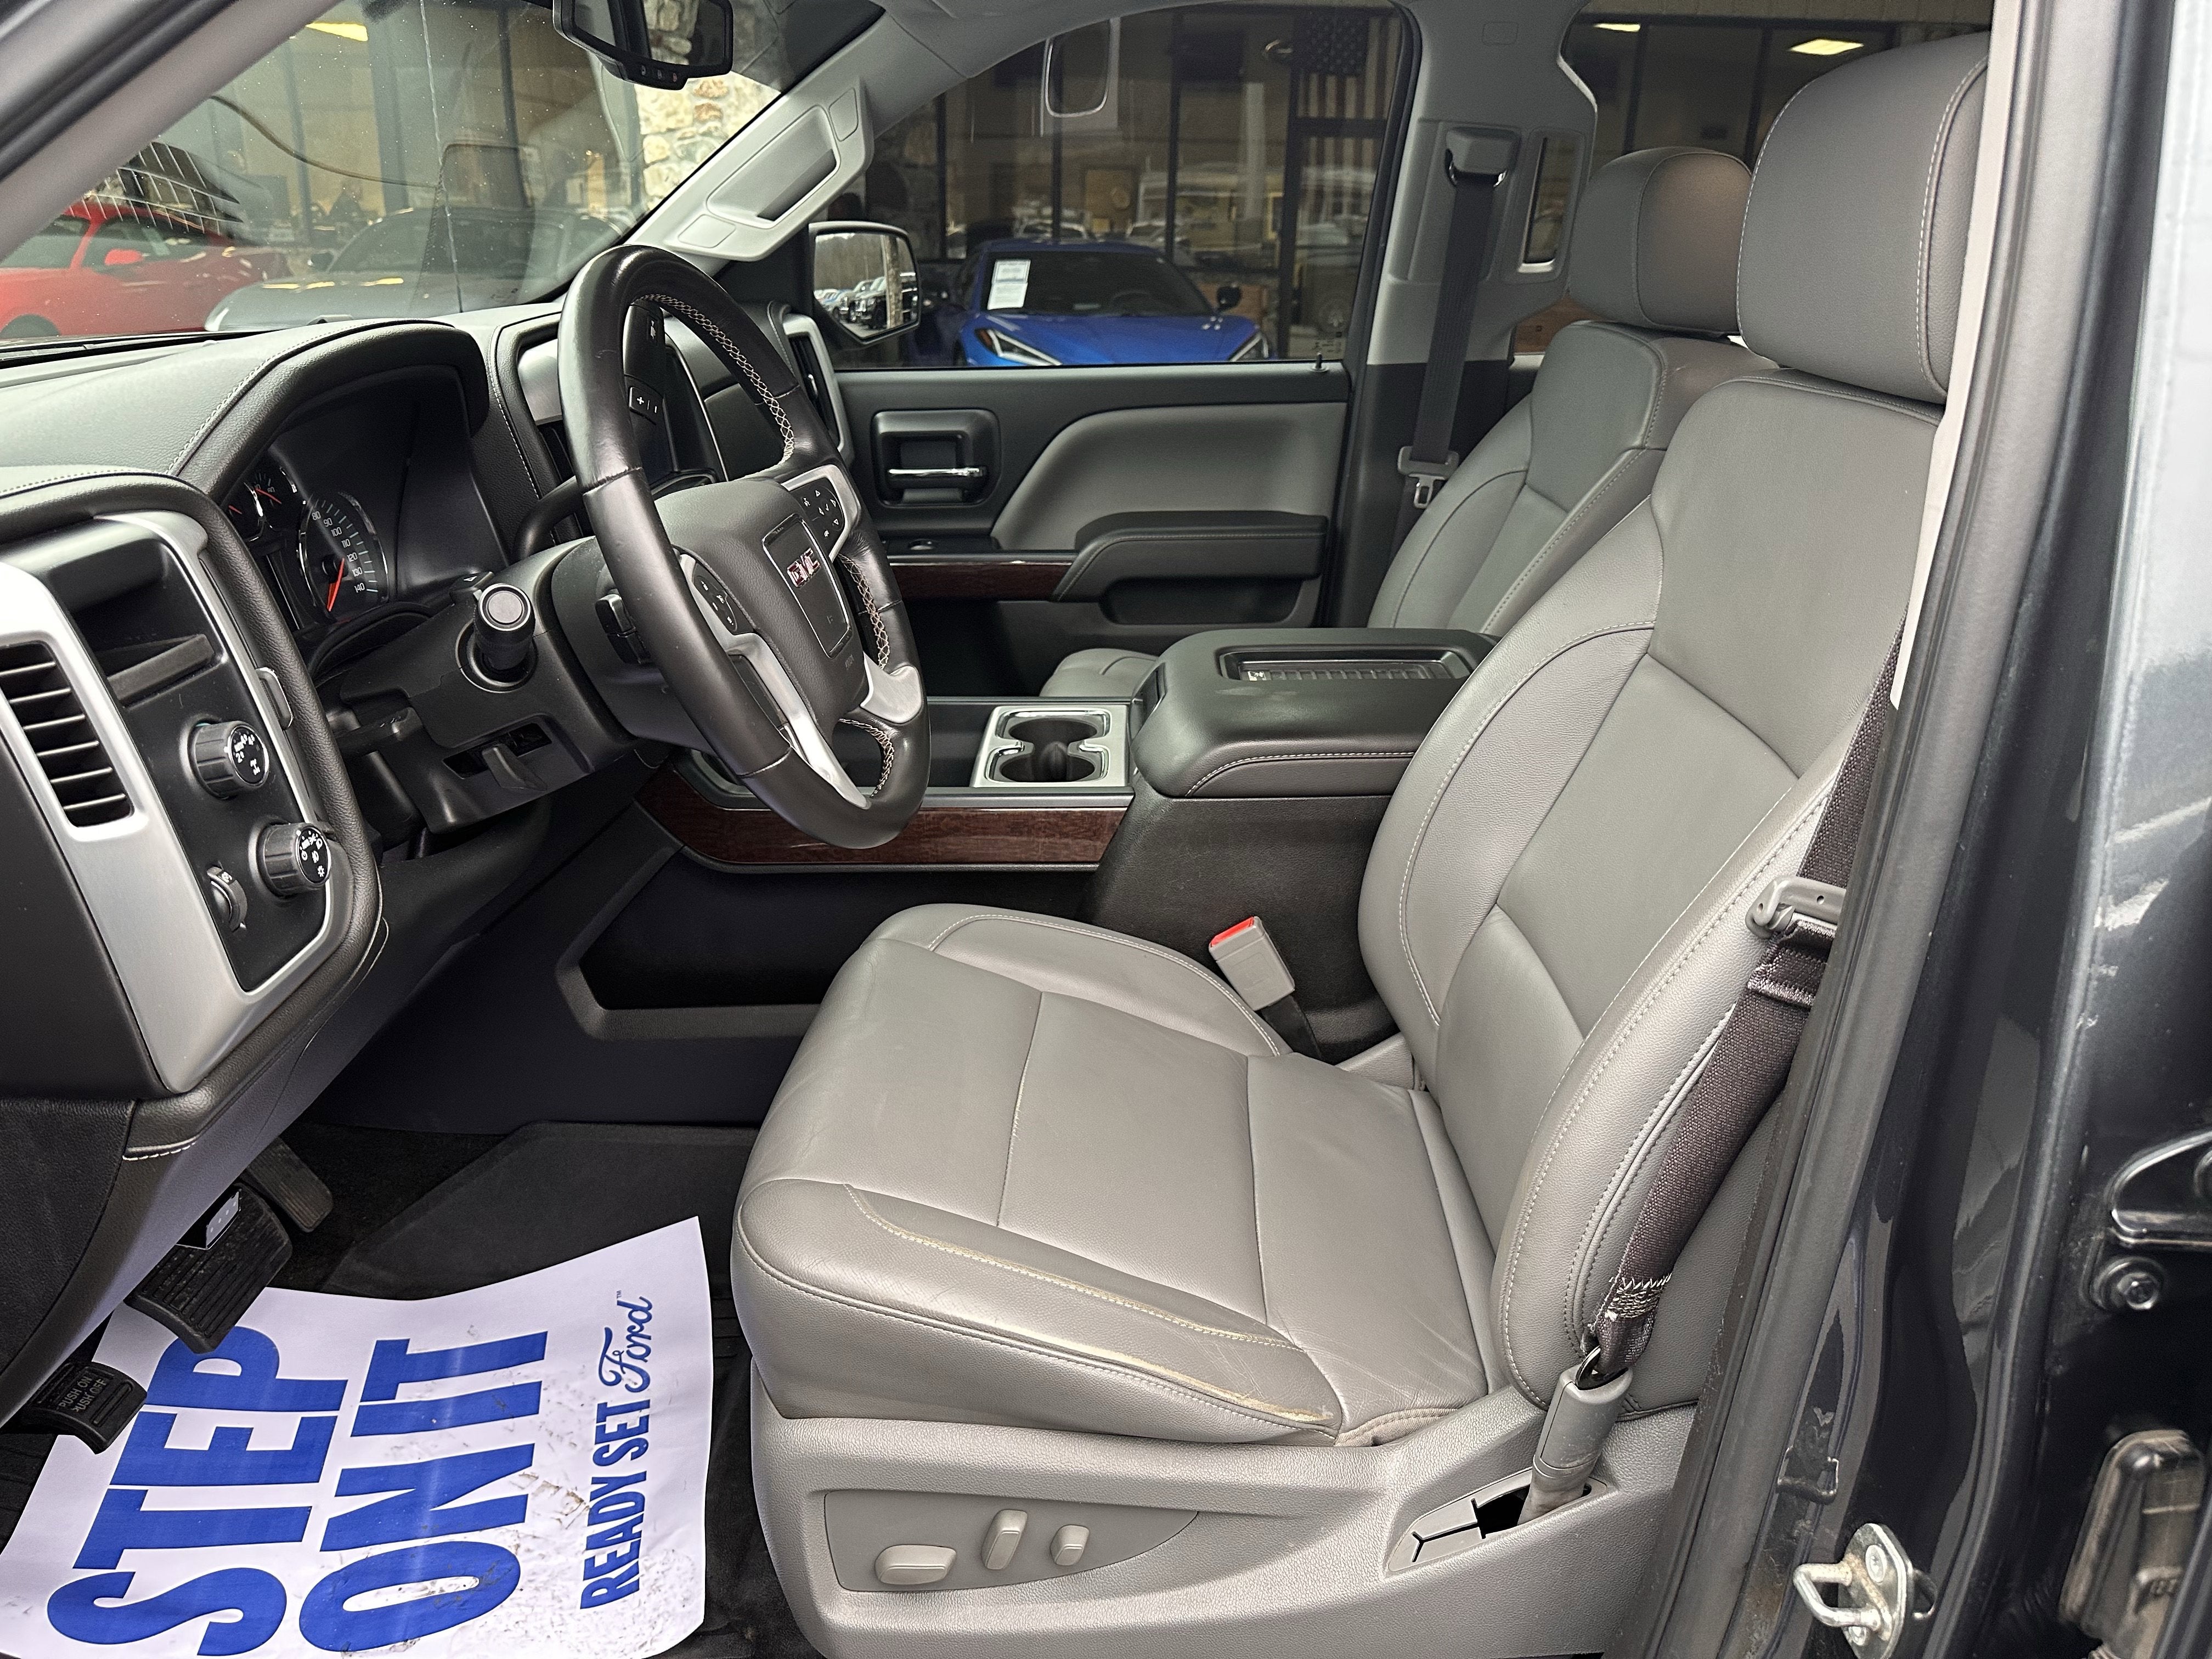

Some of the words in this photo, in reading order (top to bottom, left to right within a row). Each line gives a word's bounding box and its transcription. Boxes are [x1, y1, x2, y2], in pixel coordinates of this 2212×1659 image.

[312, 511, 321, 521] 80
[323, 518, 333, 527] 90
[331, 527, 342, 537] 100
[341, 539, 351, 548] 110
[347, 552, 358, 562] 120
[787, 548, 821, 588] GMC
[352, 567, 363, 577] 130
[354, 582, 365, 593] 140
[599, 1296, 653, 1393] Ford
[58, 1388, 82, 1407] PUSH
[77, 1376, 93, 1388] ON
[89, 1379, 107, 1394] OFF
[351, 1331, 548, 1437] IT
[592, 1399, 651, 1466] SET
[47, 1327, 347, 1656] STEP
[299, 1443, 535, 1652] ON
[580, 1470, 647, 1610] READY
